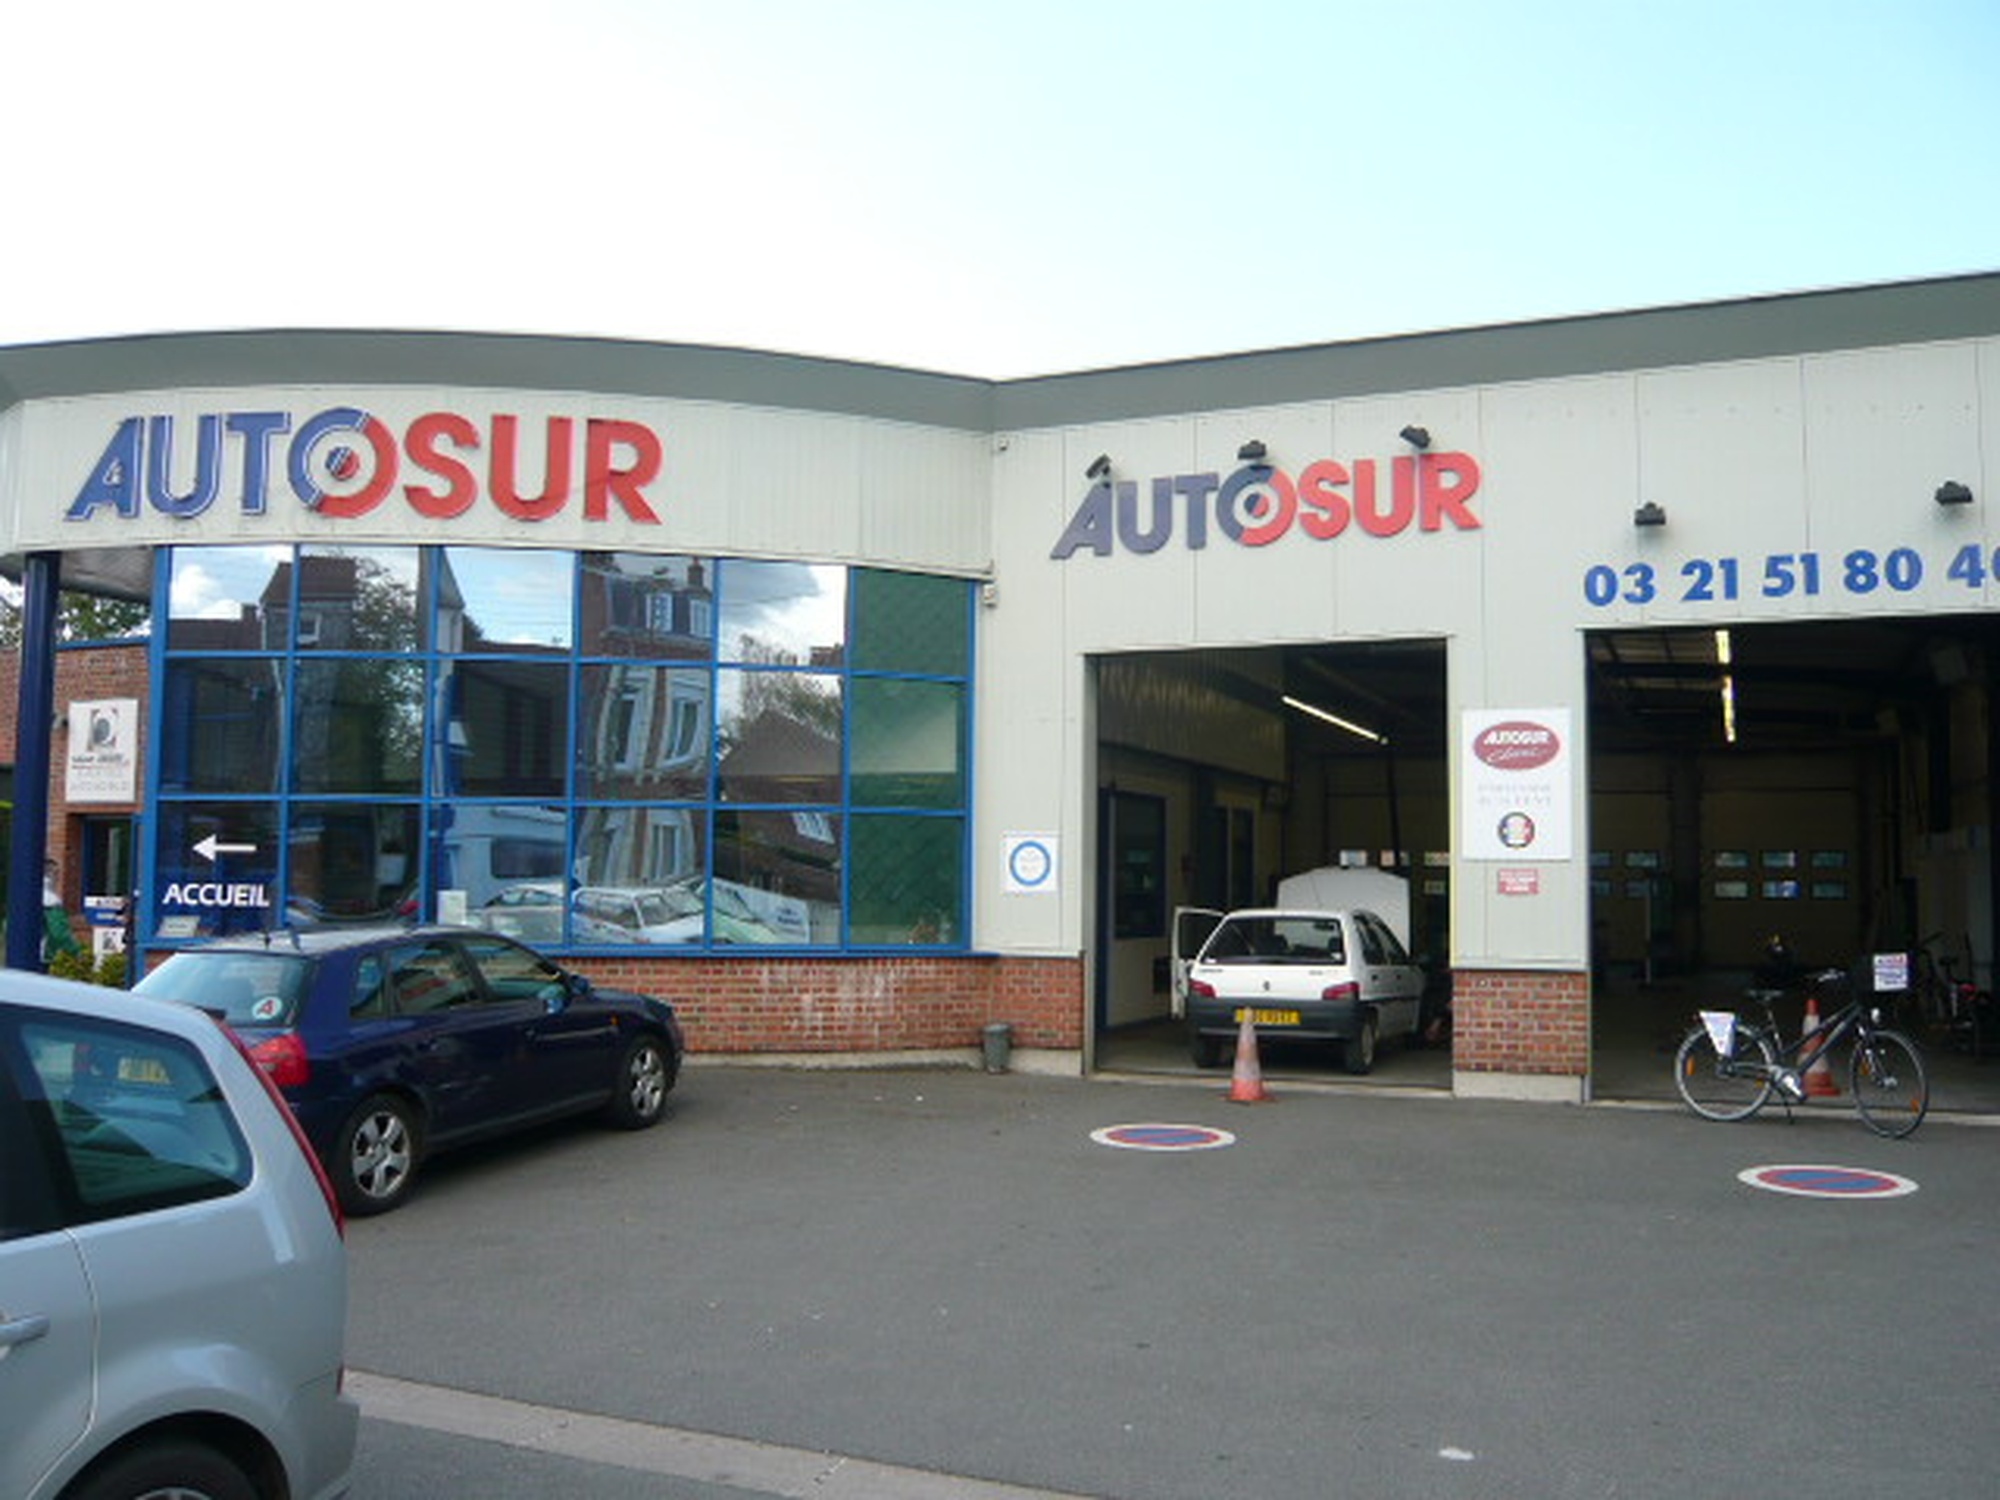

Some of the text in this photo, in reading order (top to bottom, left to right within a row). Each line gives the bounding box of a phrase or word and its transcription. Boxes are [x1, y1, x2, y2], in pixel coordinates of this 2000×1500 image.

[63, 407, 663, 525] AUTOSUR
[1050, 451, 1482, 560] AUTOSUR
[1584, 543, 2000, 607] 03 21 51 80 4
[162, 883, 270, 907] ACCUEIL
